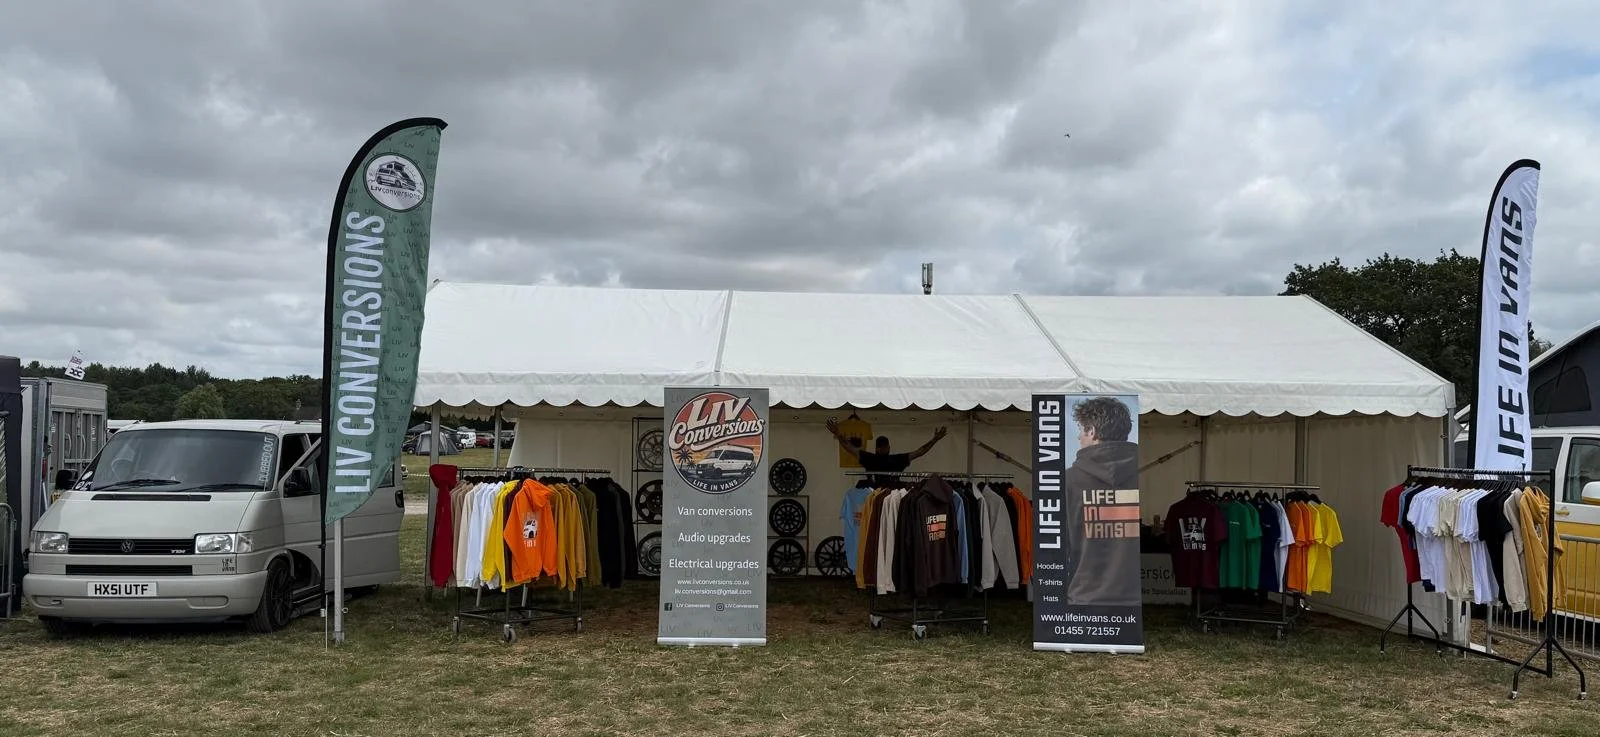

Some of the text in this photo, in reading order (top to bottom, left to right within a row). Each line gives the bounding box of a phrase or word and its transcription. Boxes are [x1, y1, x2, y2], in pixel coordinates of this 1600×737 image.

[1499, 196, 1523, 315] VANS
[335, 211, 386, 493] LIV CONVERSIONS
[686, 397, 750, 430] LIV
[669, 419, 766, 450] Conversions
[1038, 400, 1061, 549] LIFE IN VANS
[692, 479, 708, 490] LIFE
[721, 480, 738, 491] VANS
[1083, 489, 1114, 505] LIFE
[677, 506, 753, 516] Van conversions
[1084, 522, 1124, 539] VANS
[678, 532, 751, 545] Audio upgrades
[669, 558, 759, 571] Electrical upgrades
[94, 583, 149, 595] HX51 UTF
[1040, 613, 1137, 624] www.lifeinvans.co.uk
[1054, 626, 1121, 636] 01455 721557
